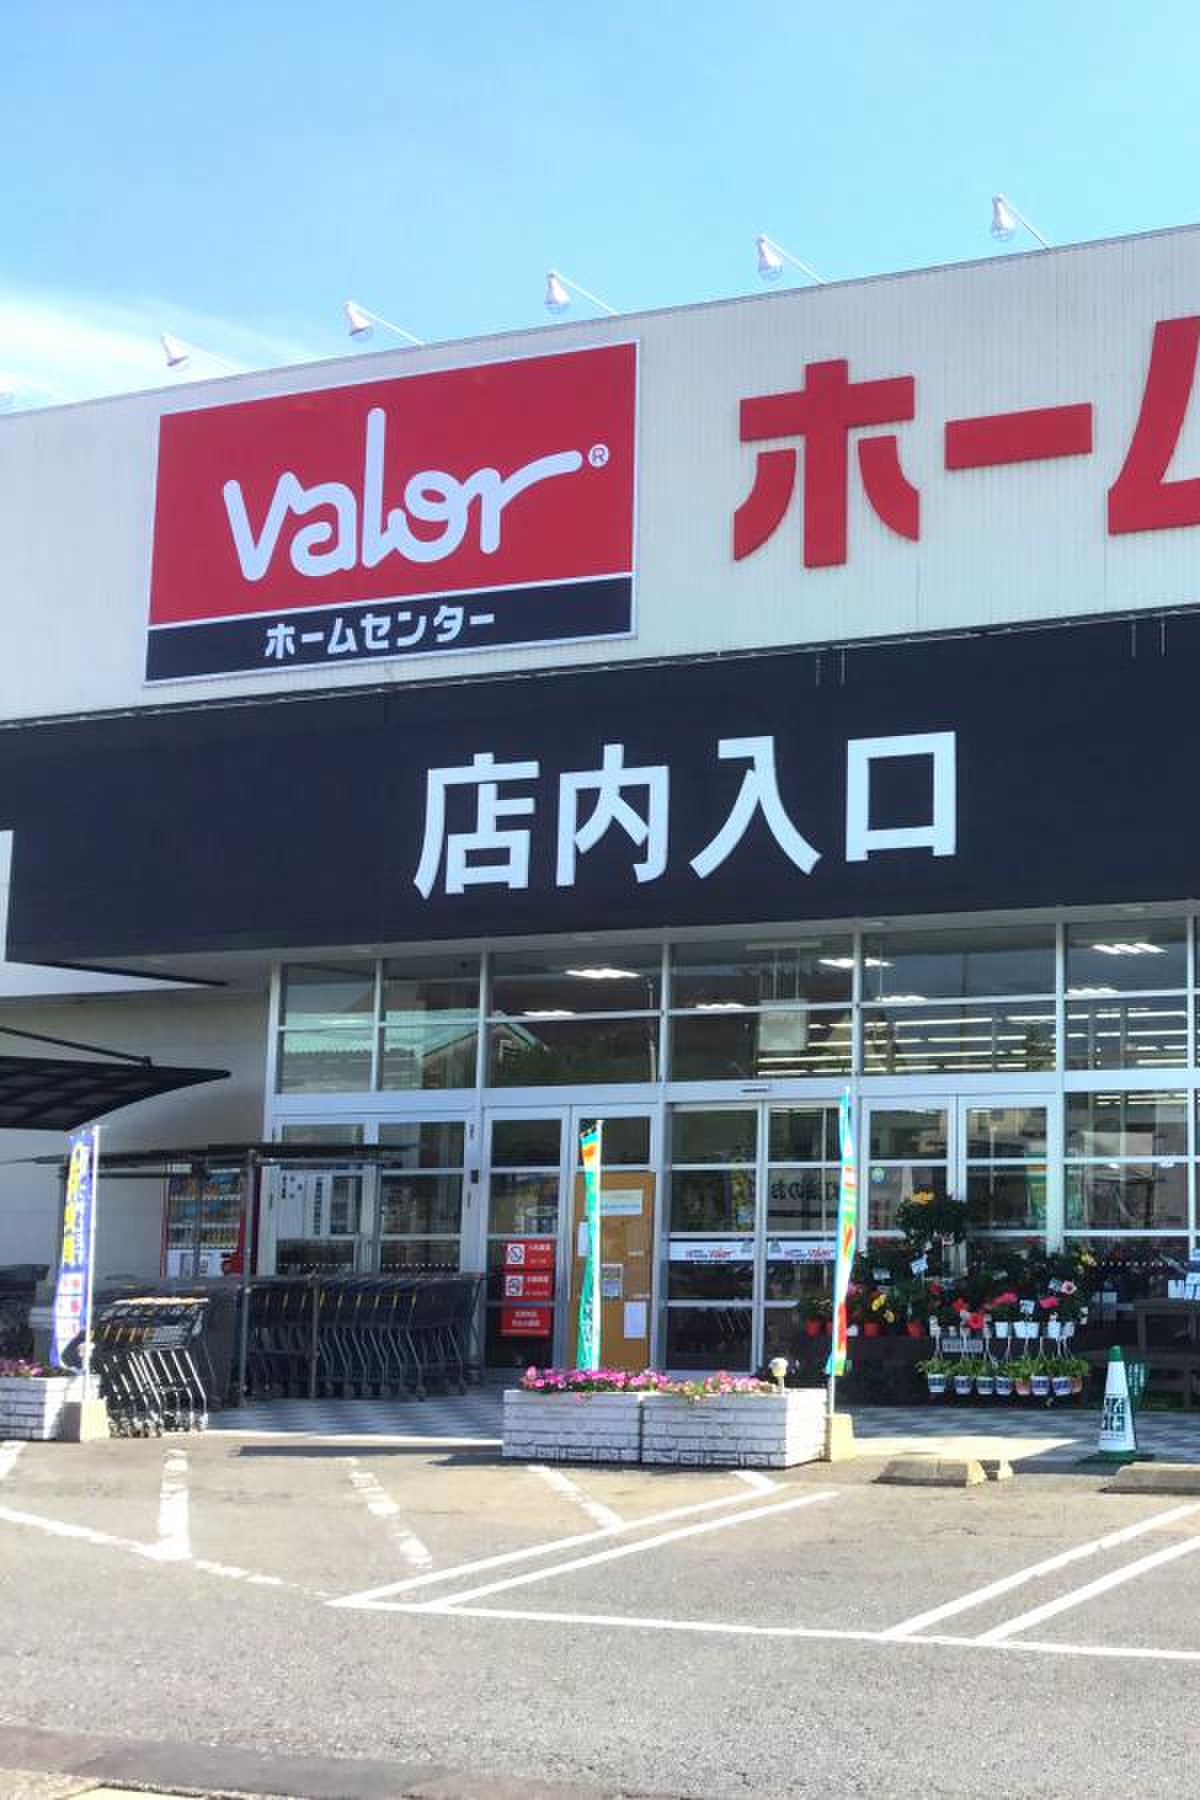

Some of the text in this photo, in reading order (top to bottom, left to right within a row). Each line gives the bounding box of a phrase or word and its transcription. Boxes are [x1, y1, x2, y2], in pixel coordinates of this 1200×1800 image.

[264, 605, 495, 660] ホームセンター
[413, 731, 957, 899] 店内入口
